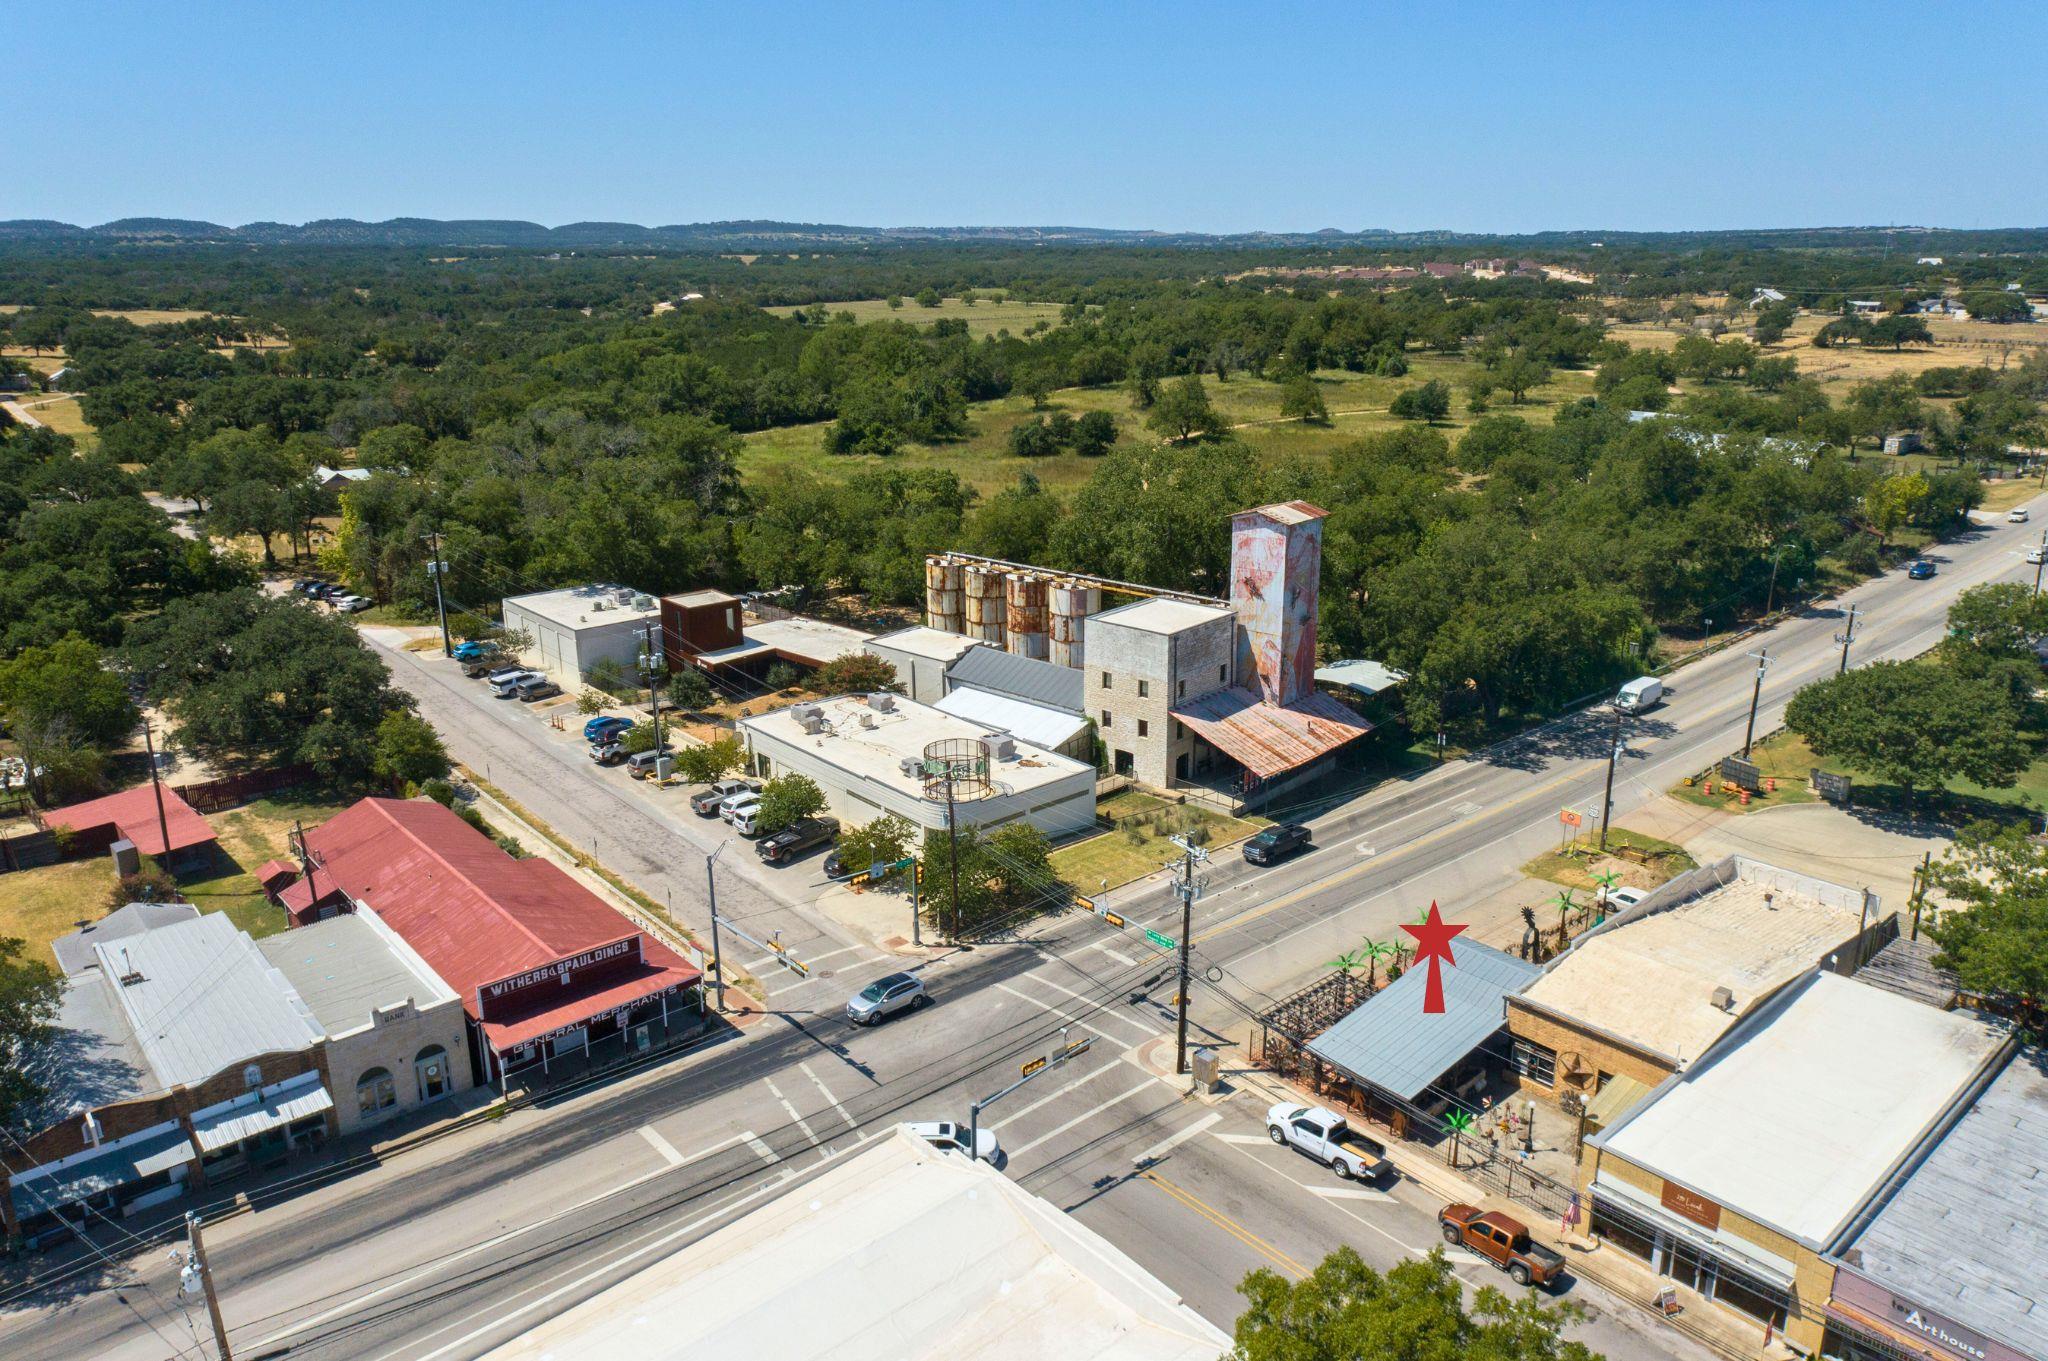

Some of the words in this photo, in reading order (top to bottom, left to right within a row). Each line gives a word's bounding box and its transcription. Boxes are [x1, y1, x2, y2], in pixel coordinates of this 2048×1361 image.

[490, 968, 549, 998] WITHERS
[513, 1022, 586, 1054] GENERAL
[591, 985, 678, 1024] MERCHANTS
